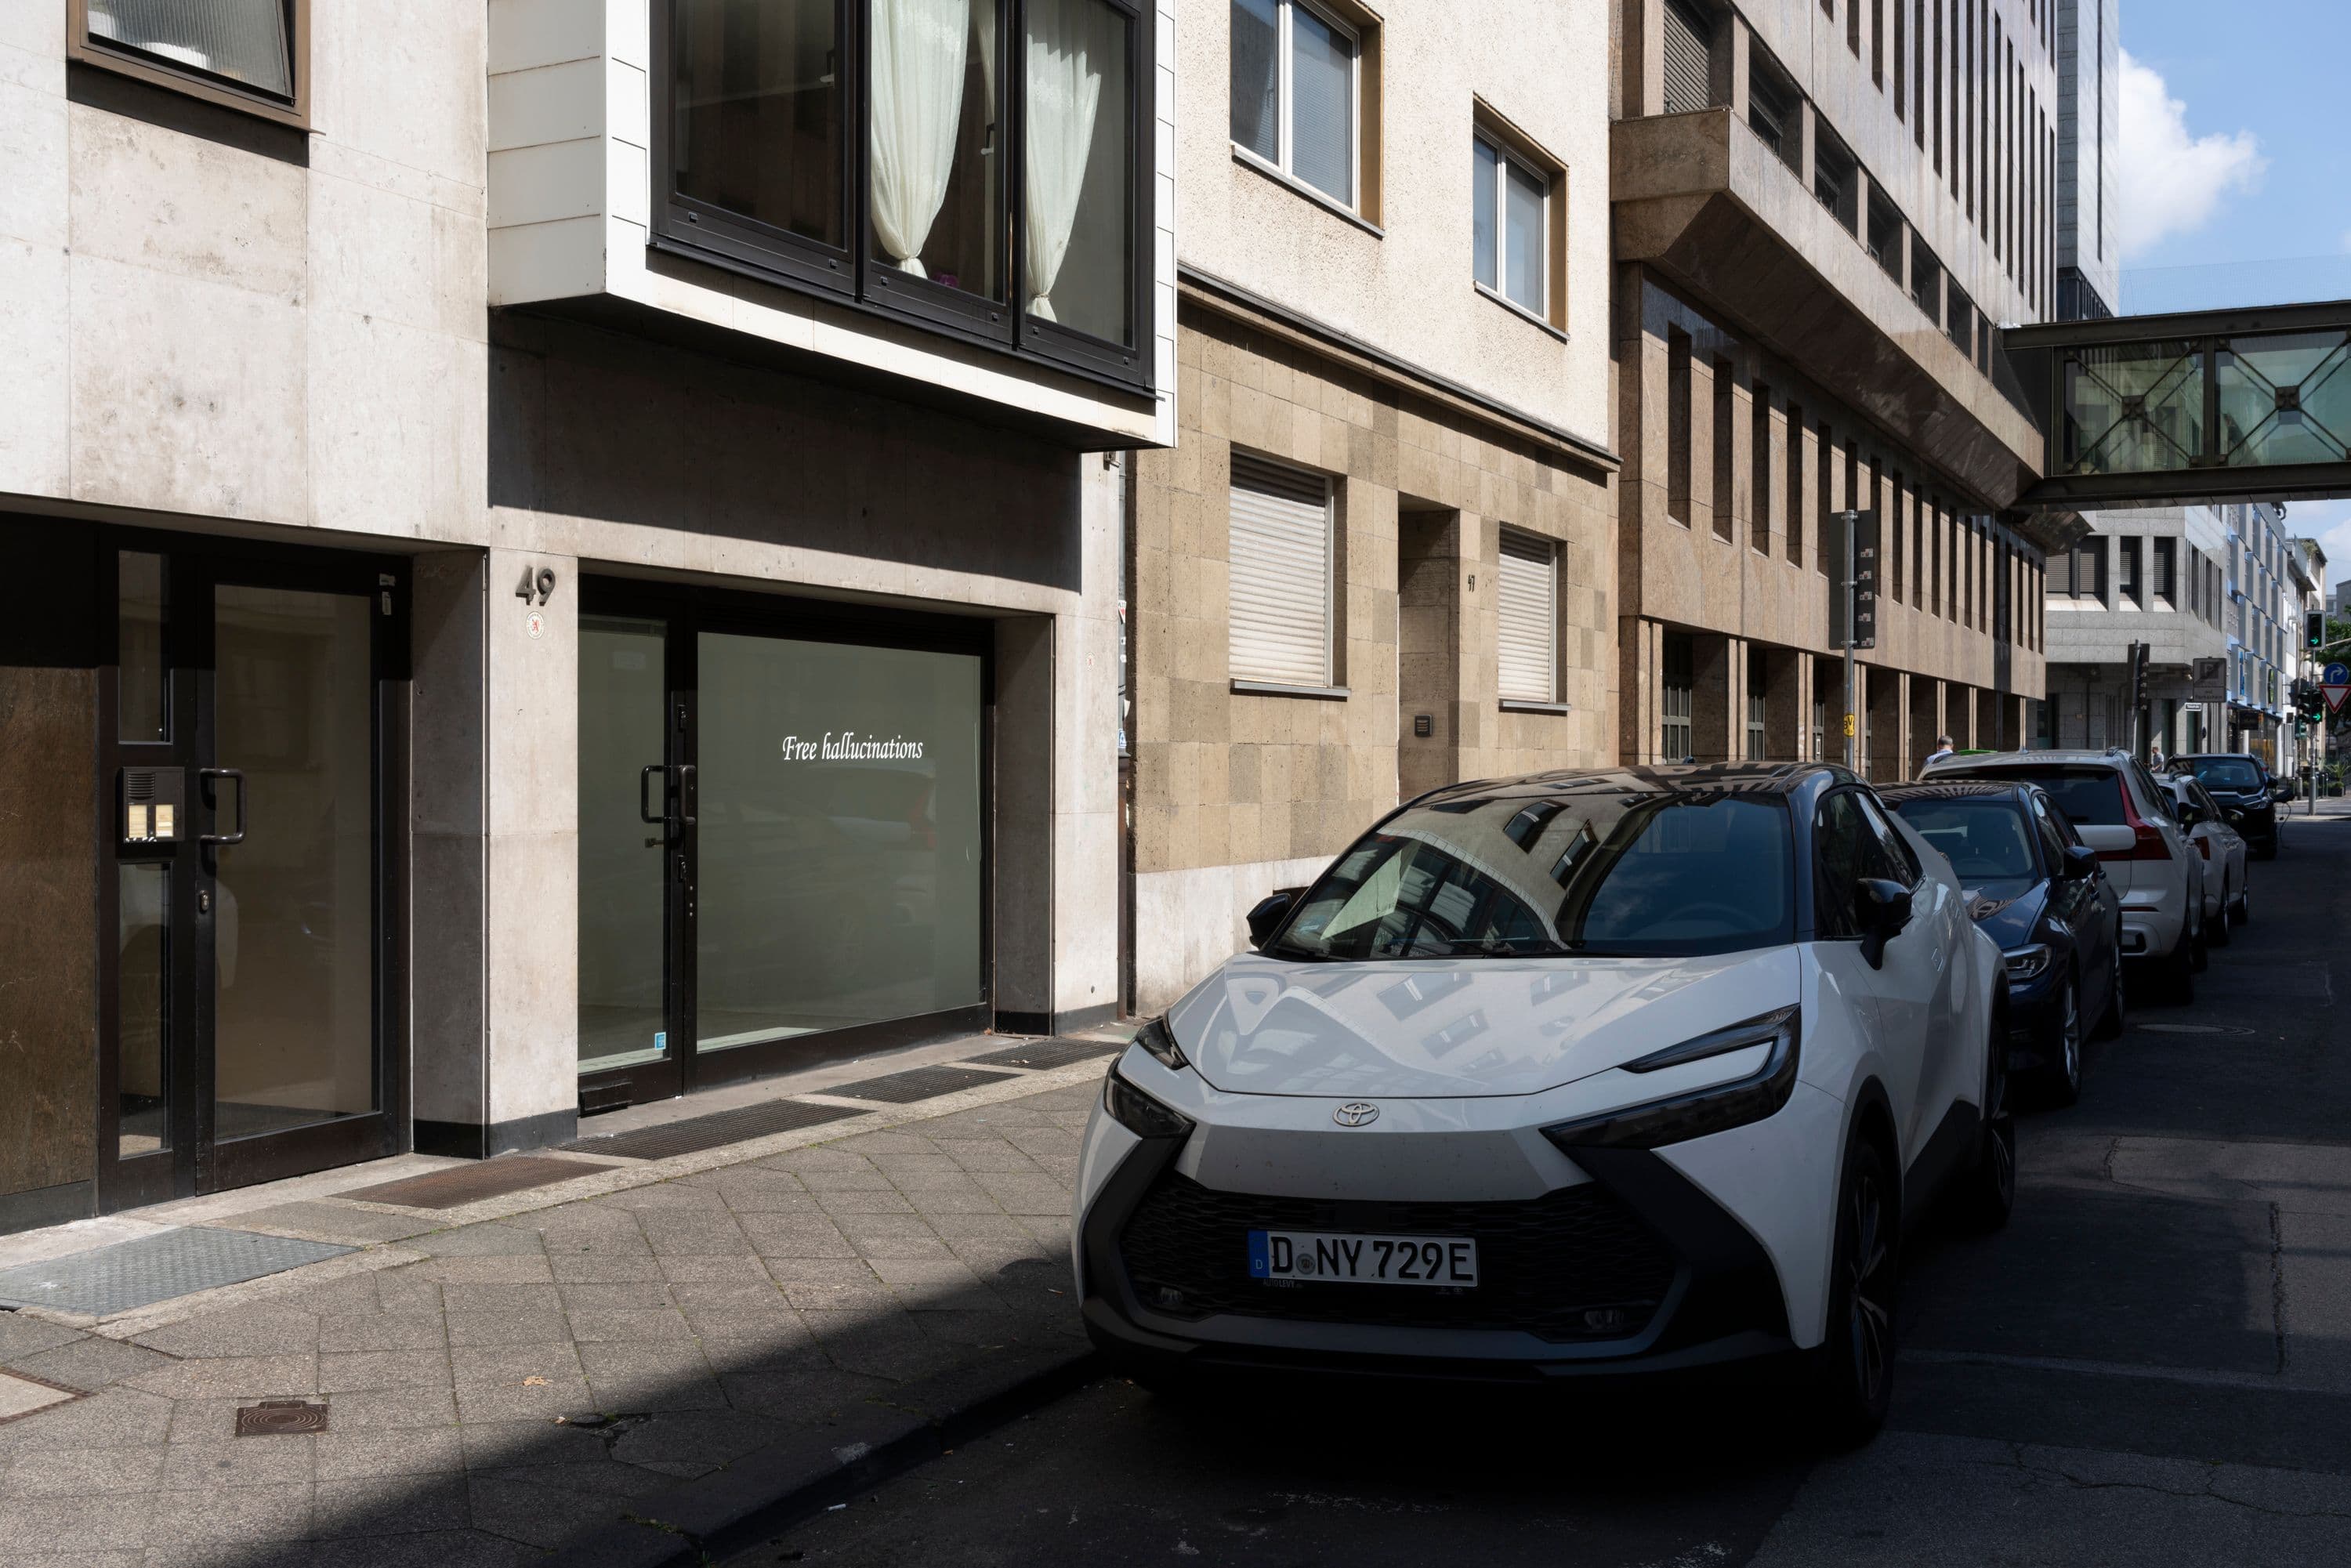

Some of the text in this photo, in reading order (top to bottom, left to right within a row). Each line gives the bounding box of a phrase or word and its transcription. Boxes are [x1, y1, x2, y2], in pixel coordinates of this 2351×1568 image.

[516, 566, 556, 607] 49
[1468, 574, 1475, 592] 47
[782, 732, 923, 760] Free hallucinations
[1270, 1236, 1293, 1273] D
[1316, 1238, 1363, 1276] NY
[1373, 1240, 1474, 1281] 729E
